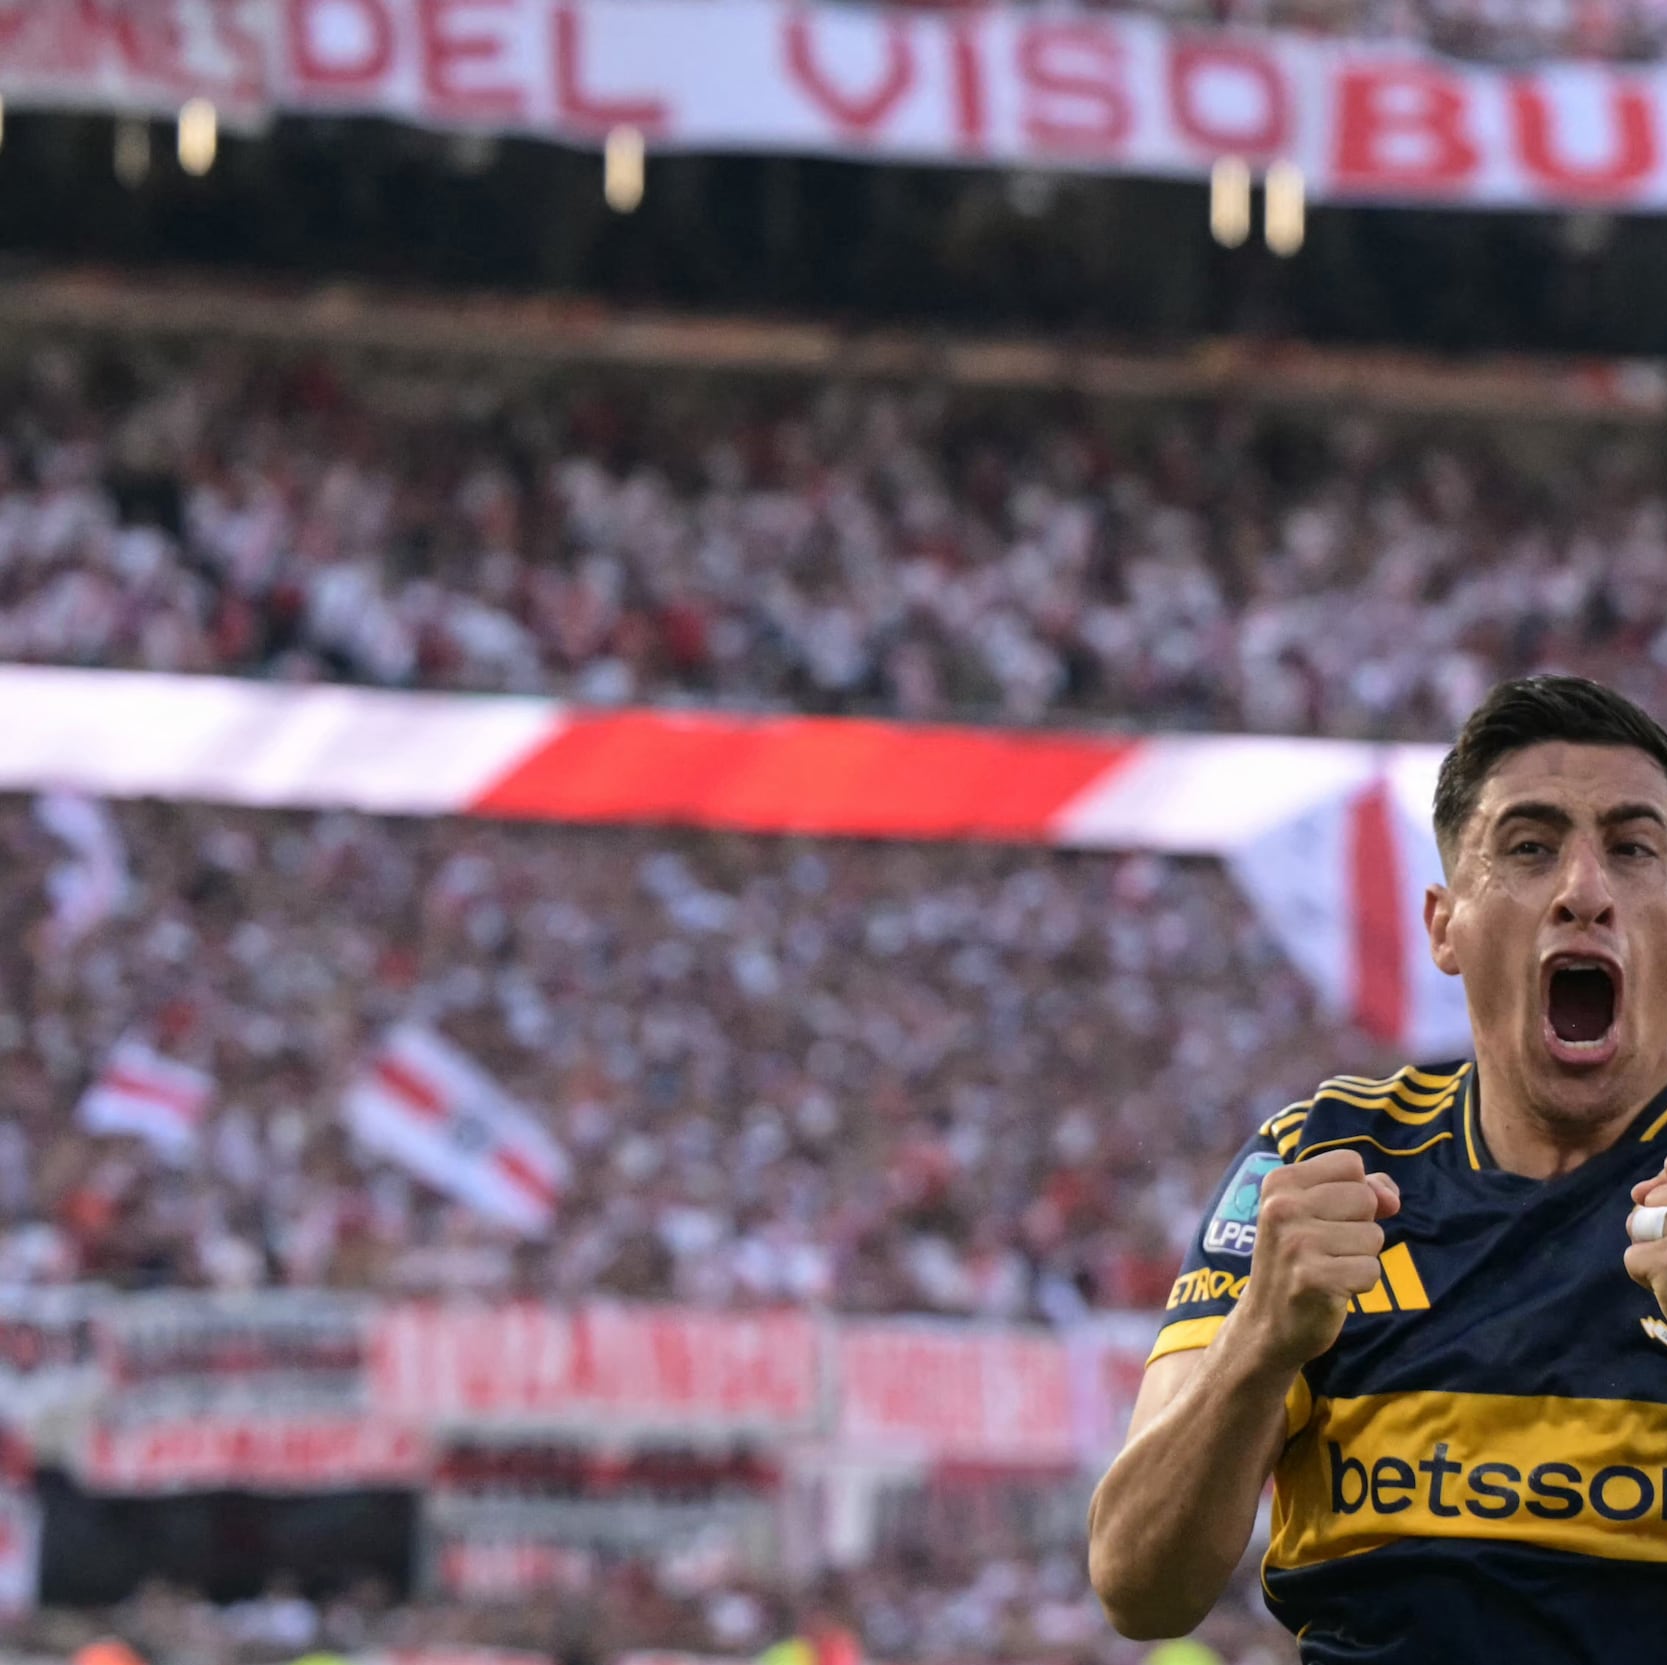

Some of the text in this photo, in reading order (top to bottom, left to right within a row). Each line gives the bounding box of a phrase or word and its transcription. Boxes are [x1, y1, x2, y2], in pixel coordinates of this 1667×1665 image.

[283, 0, 672, 128] DEL
[785, 5, 1292, 166] VISO
[1208, 1221, 1258, 1250] LPF
